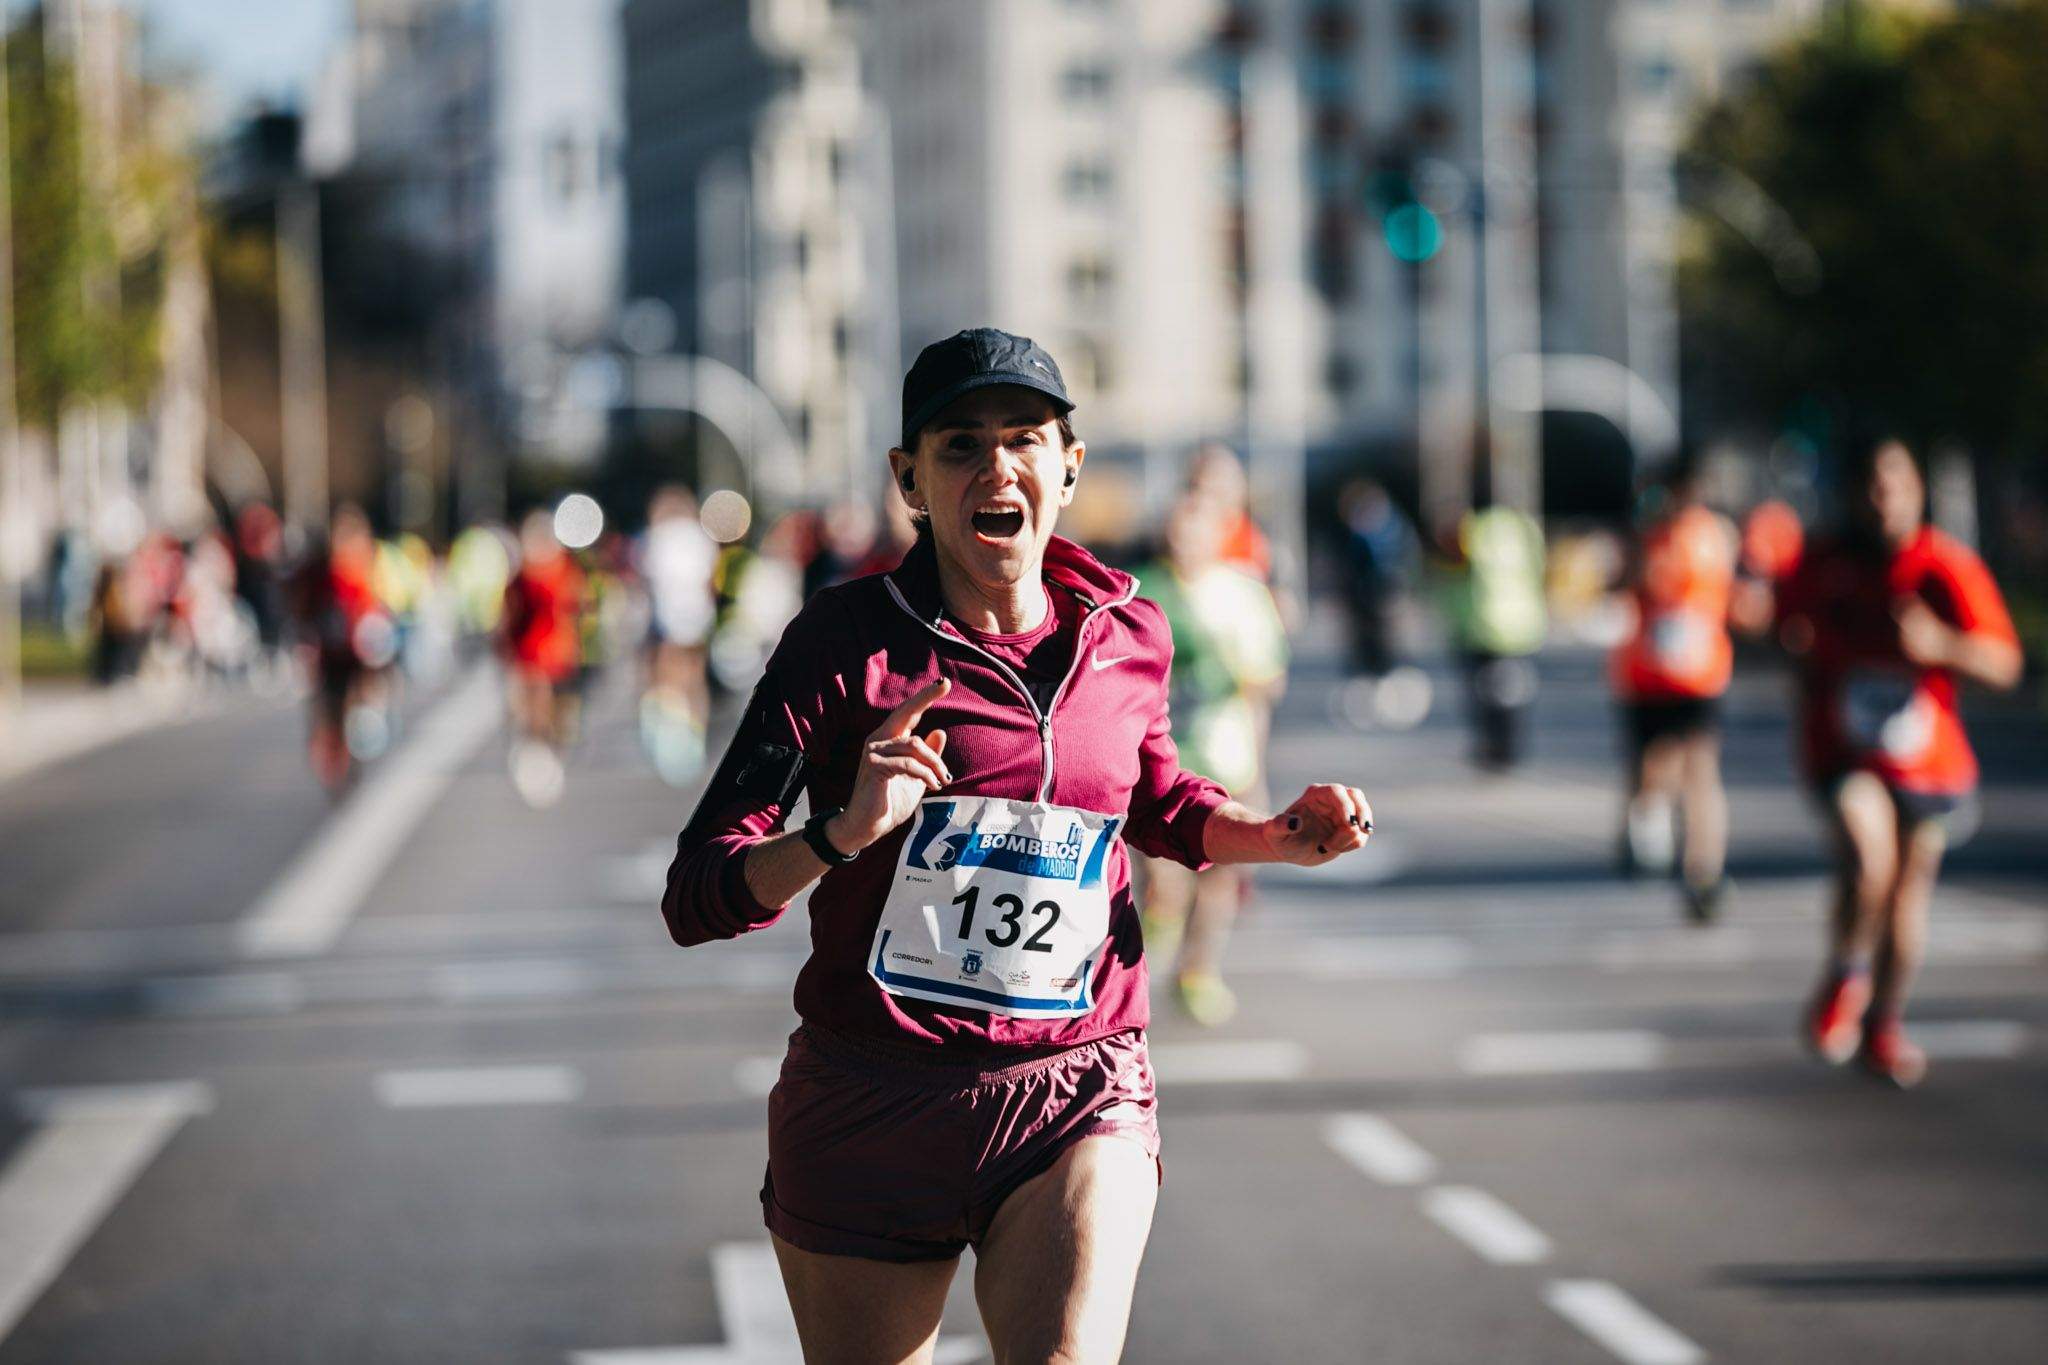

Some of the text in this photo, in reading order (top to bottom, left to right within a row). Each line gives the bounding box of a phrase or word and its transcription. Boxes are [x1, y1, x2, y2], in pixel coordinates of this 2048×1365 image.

[979, 834, 1079, 860] BOMBEROS
[1018, 855, 1075, 878] de MADRID
[952, 886, 1061, 952] 132
